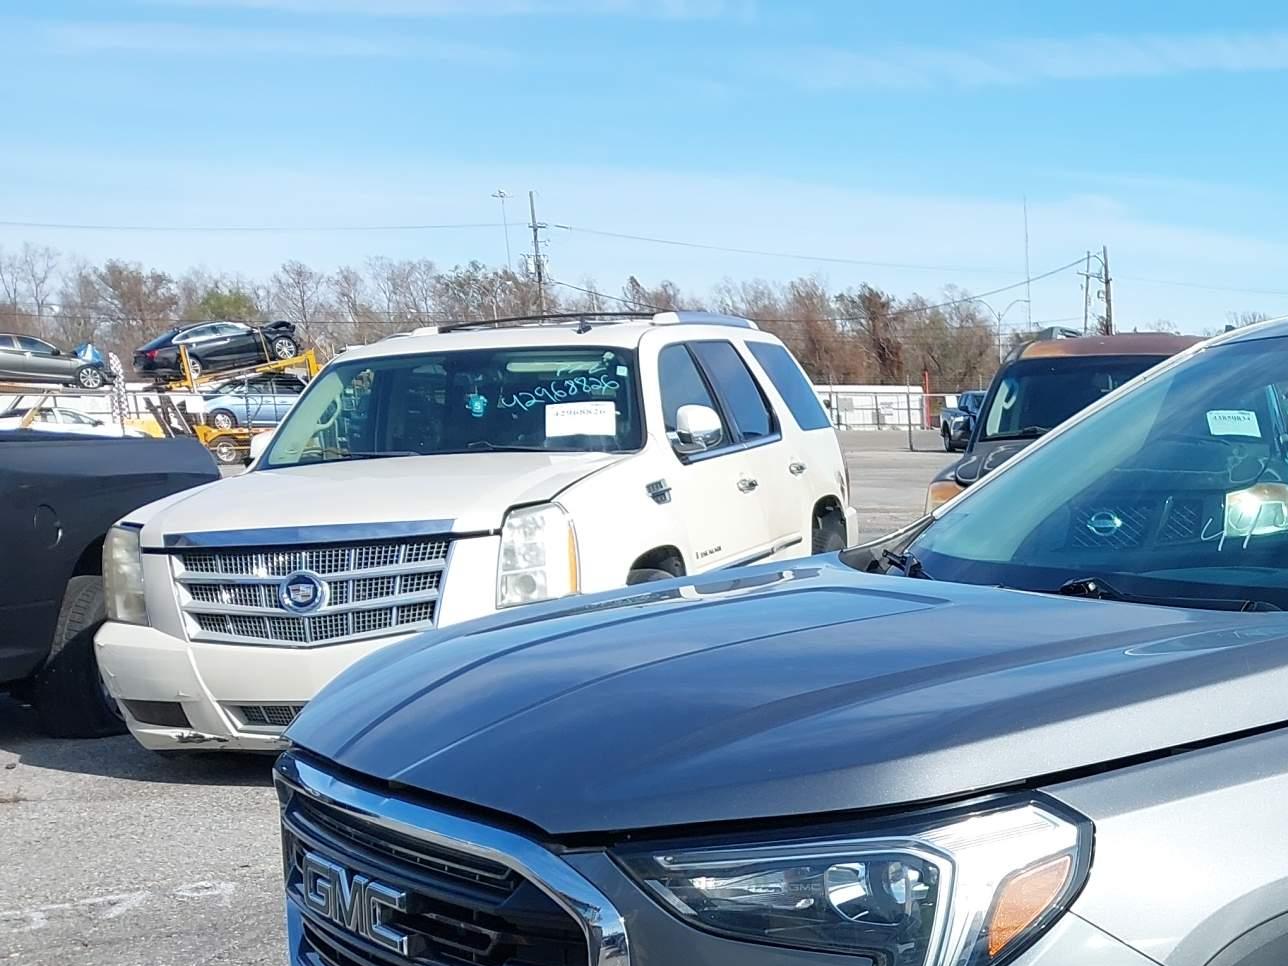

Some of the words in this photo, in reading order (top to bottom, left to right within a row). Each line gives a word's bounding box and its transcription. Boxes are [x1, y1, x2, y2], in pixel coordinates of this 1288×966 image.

[501, 374, 620, 411] 42968826
[303, 852, 408, 957] GMC
[789, 883, 821, 892] GMC
